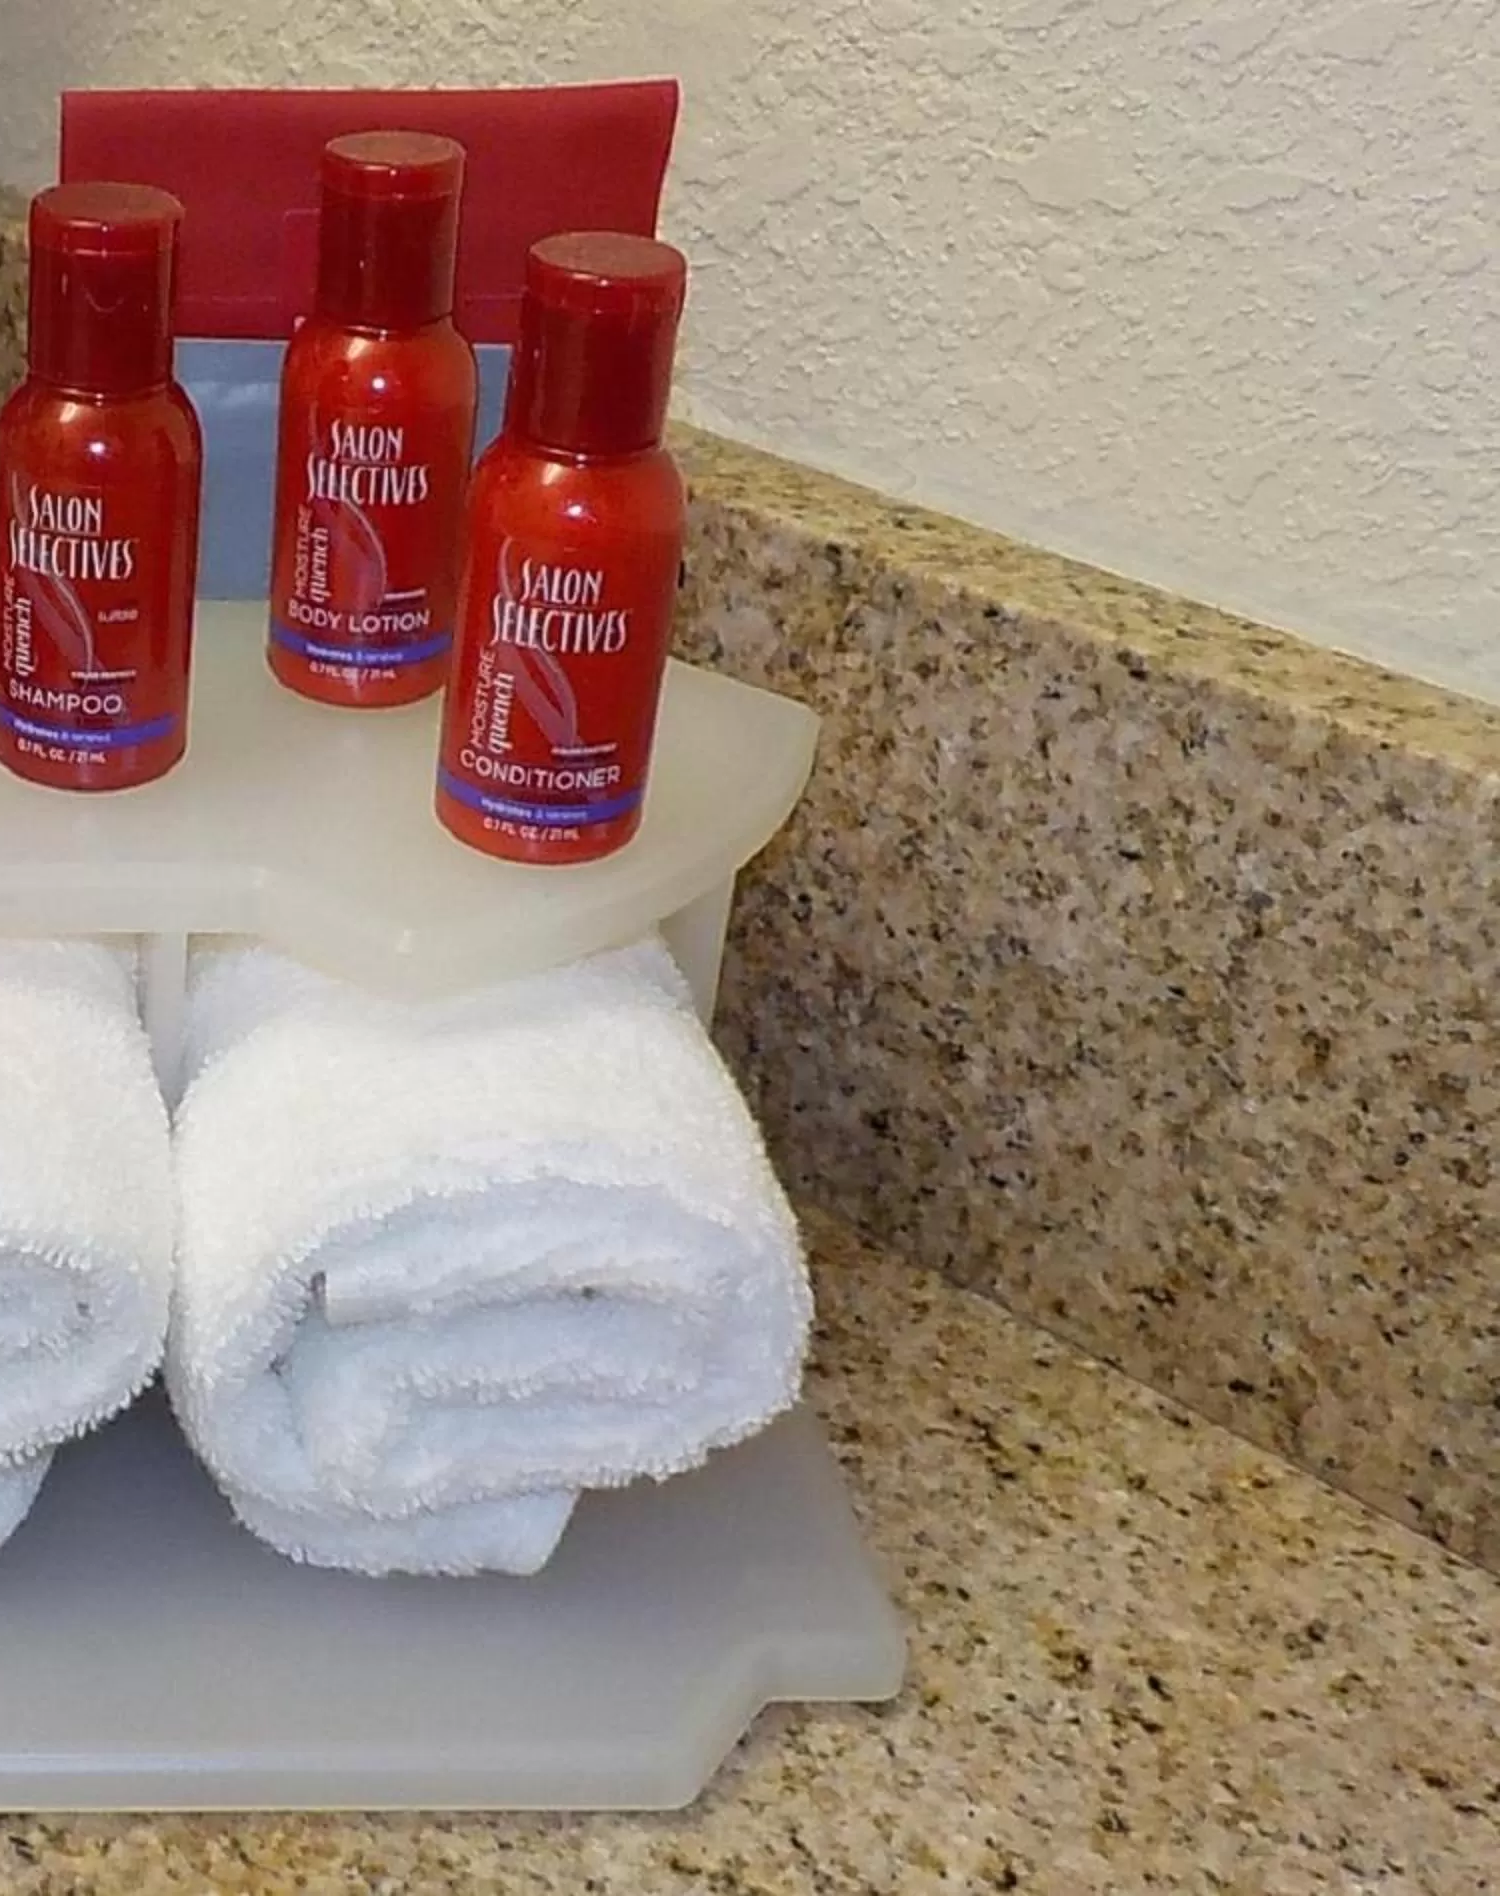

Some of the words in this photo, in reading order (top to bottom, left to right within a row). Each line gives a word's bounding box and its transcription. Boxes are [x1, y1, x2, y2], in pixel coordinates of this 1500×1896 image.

[331, 418, 403, 461] SALON
[306, 451, 430, 507] SELECTIVES
[29, 483, 102, 534] SALON
[9, 519, 133, 581] SELECTIVES
[308, 526, 333, 603] quench
[520, 556, 604, 604] SALON
[13, 597, 37, 677] quench
[287, 598, 343, 631] BODY
[347, 607, 431, 634] LOTION
[489, 591, 628, 655] SELECTIVES
[8, 677, 123, 715] SHAMPOO
[469, 647, 496, 750] MOISTURE
[488, 671, 515, 755] quench
[459, 748, 621, 790] CONDITIONER
